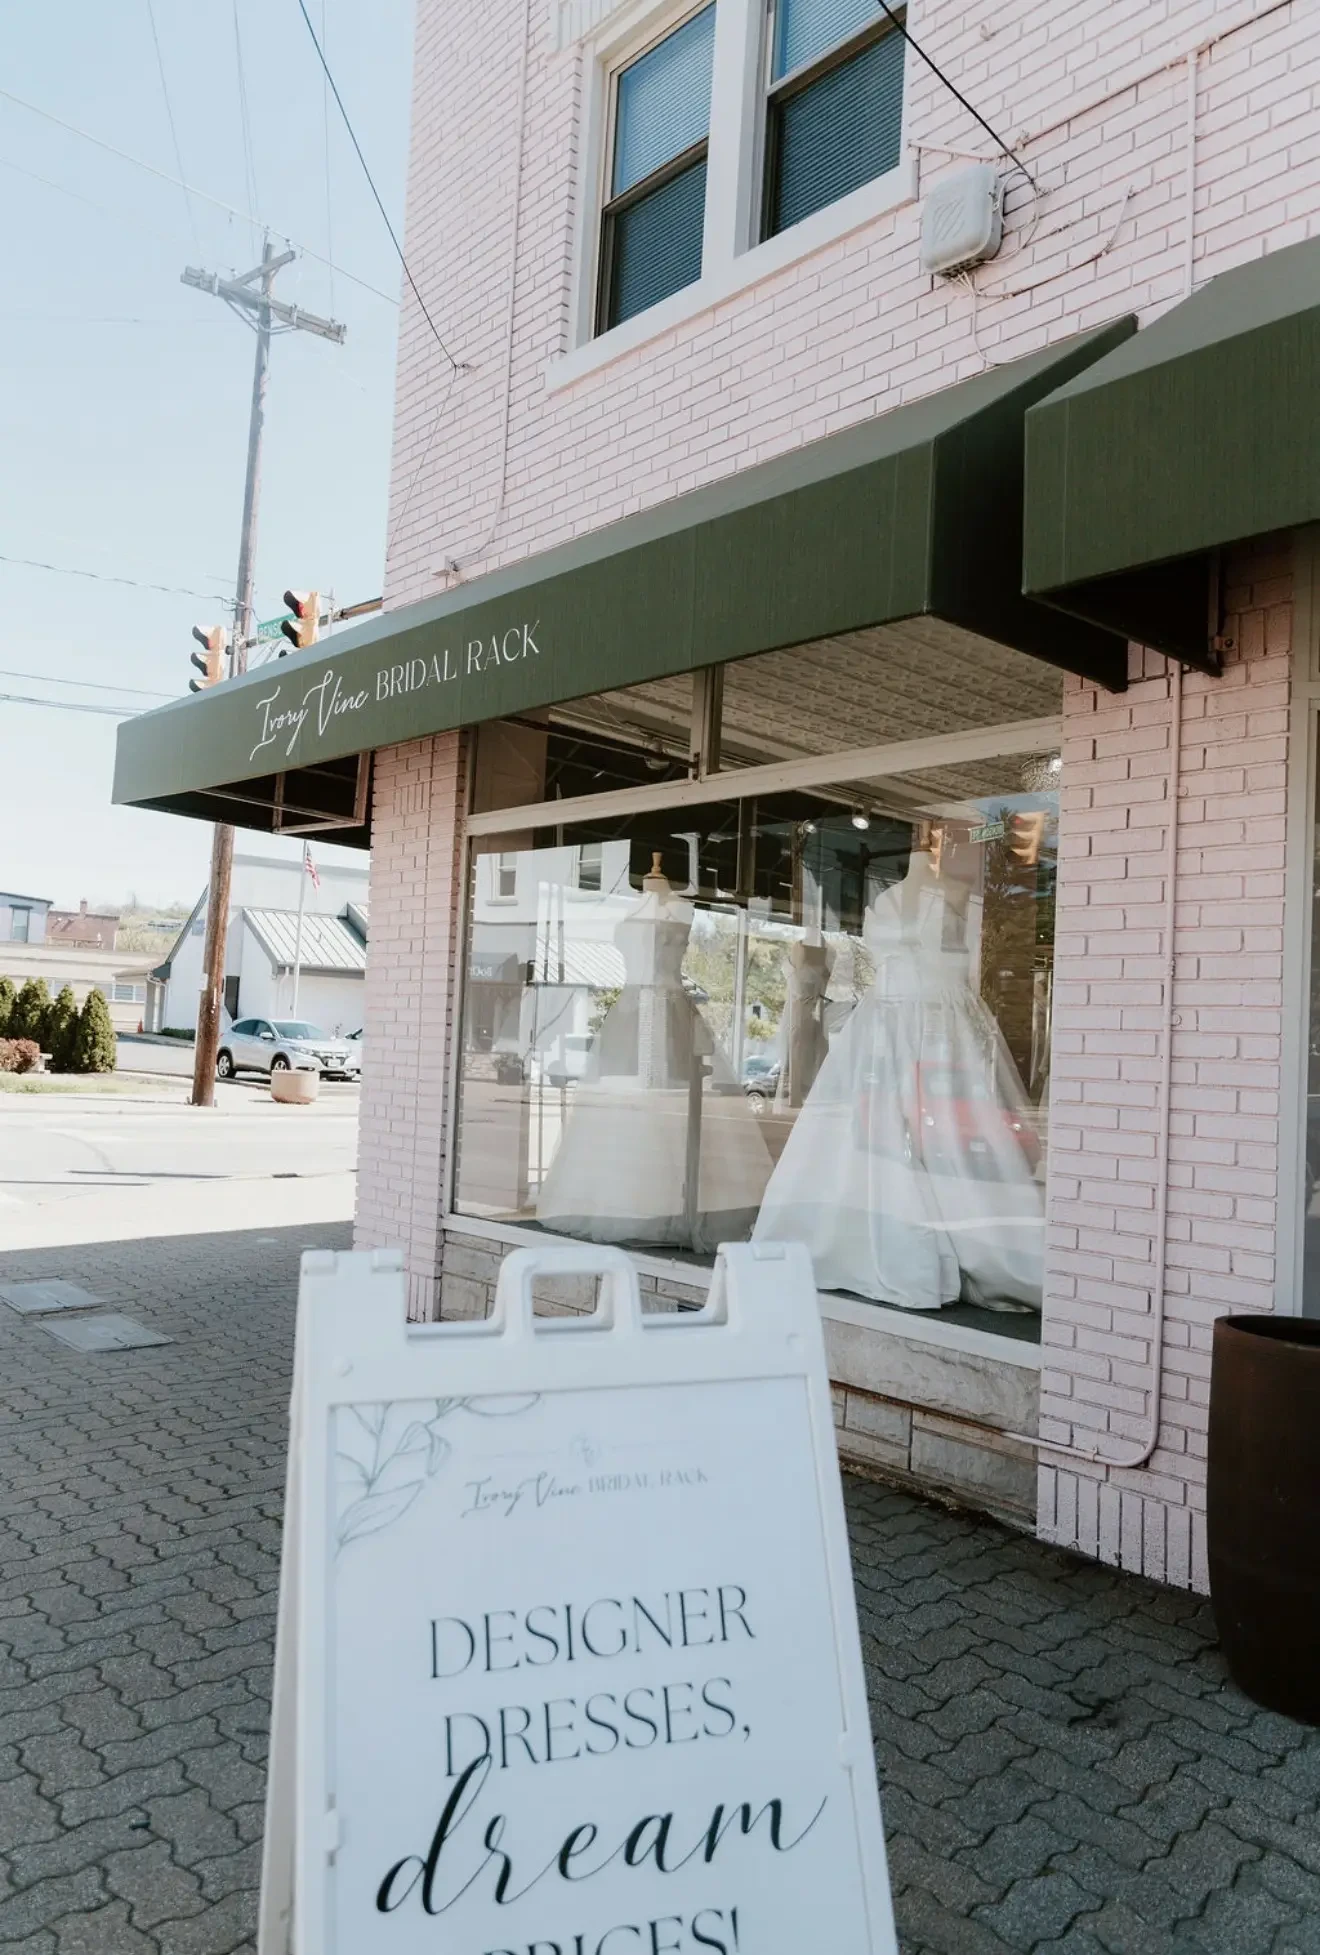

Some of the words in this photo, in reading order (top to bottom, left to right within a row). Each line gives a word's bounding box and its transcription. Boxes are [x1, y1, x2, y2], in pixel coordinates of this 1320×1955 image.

[249, 685, 309, 761] Ivory
[302, 669, 370, 736] Vine
[375, 650, 458, 701] BRIDAL
[466, 619, 541, 674] RACK
[460, 1476, 524, 1518] Ivory
[516, 1470, 581, 1508] Vine
[588, 1472, 653, 1493] BRIDAL
[659, 1466, 708, 1487] RACK
[429, 1584, 757, 1680] DESIGNER
[444, 1677, 752, 1777] DRESSES,
[375, 1752, 829, 1915] dream
[483, 1905, 741, 1955] CES!
